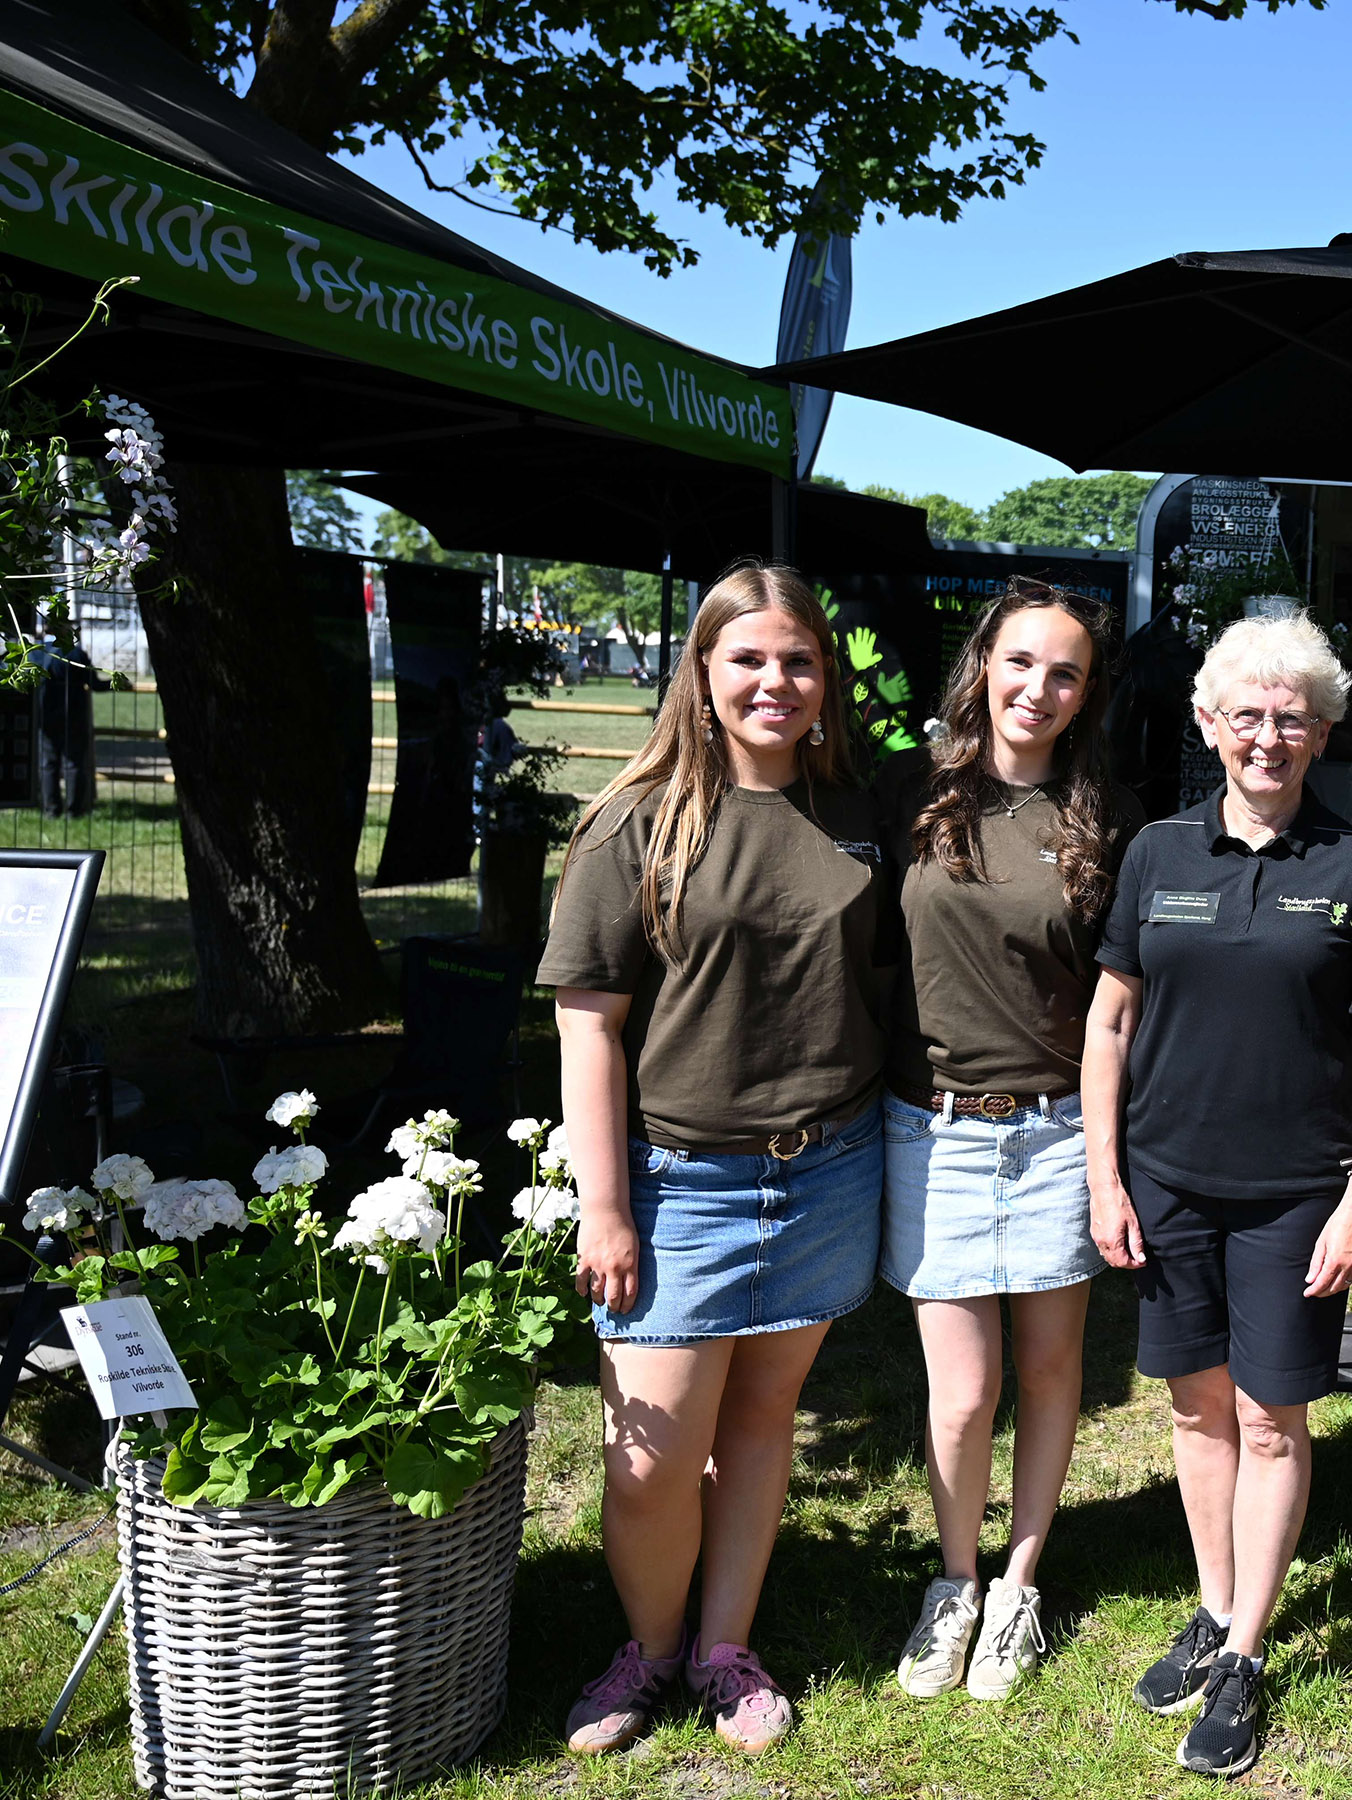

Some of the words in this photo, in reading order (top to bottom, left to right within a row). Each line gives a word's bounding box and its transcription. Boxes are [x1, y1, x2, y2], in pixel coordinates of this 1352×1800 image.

[284, 228, 518, 369] Tekniske
[530, 316, 654, 423] Skole,
[657, 362, 780, 448] Vilvorde
[1191, 480, 1269, 491] MASKINSNEDK
[1191, 504, 1280, 517] BROLÆGGE
[925, 576, 963, 593] HOP
[933, 594, 963, 612] bliv
[1179, 768, 1225, 781] IT-SUPP
[115, 1331, 133, 1341] Stand
[125, 1344, 144, 1357] 306
[98, 1371, 130, 1383] Roskilde
[130, 1365, 162, 1377] Tekniske
[132, 1380, 164, 1392] Vilvorde
